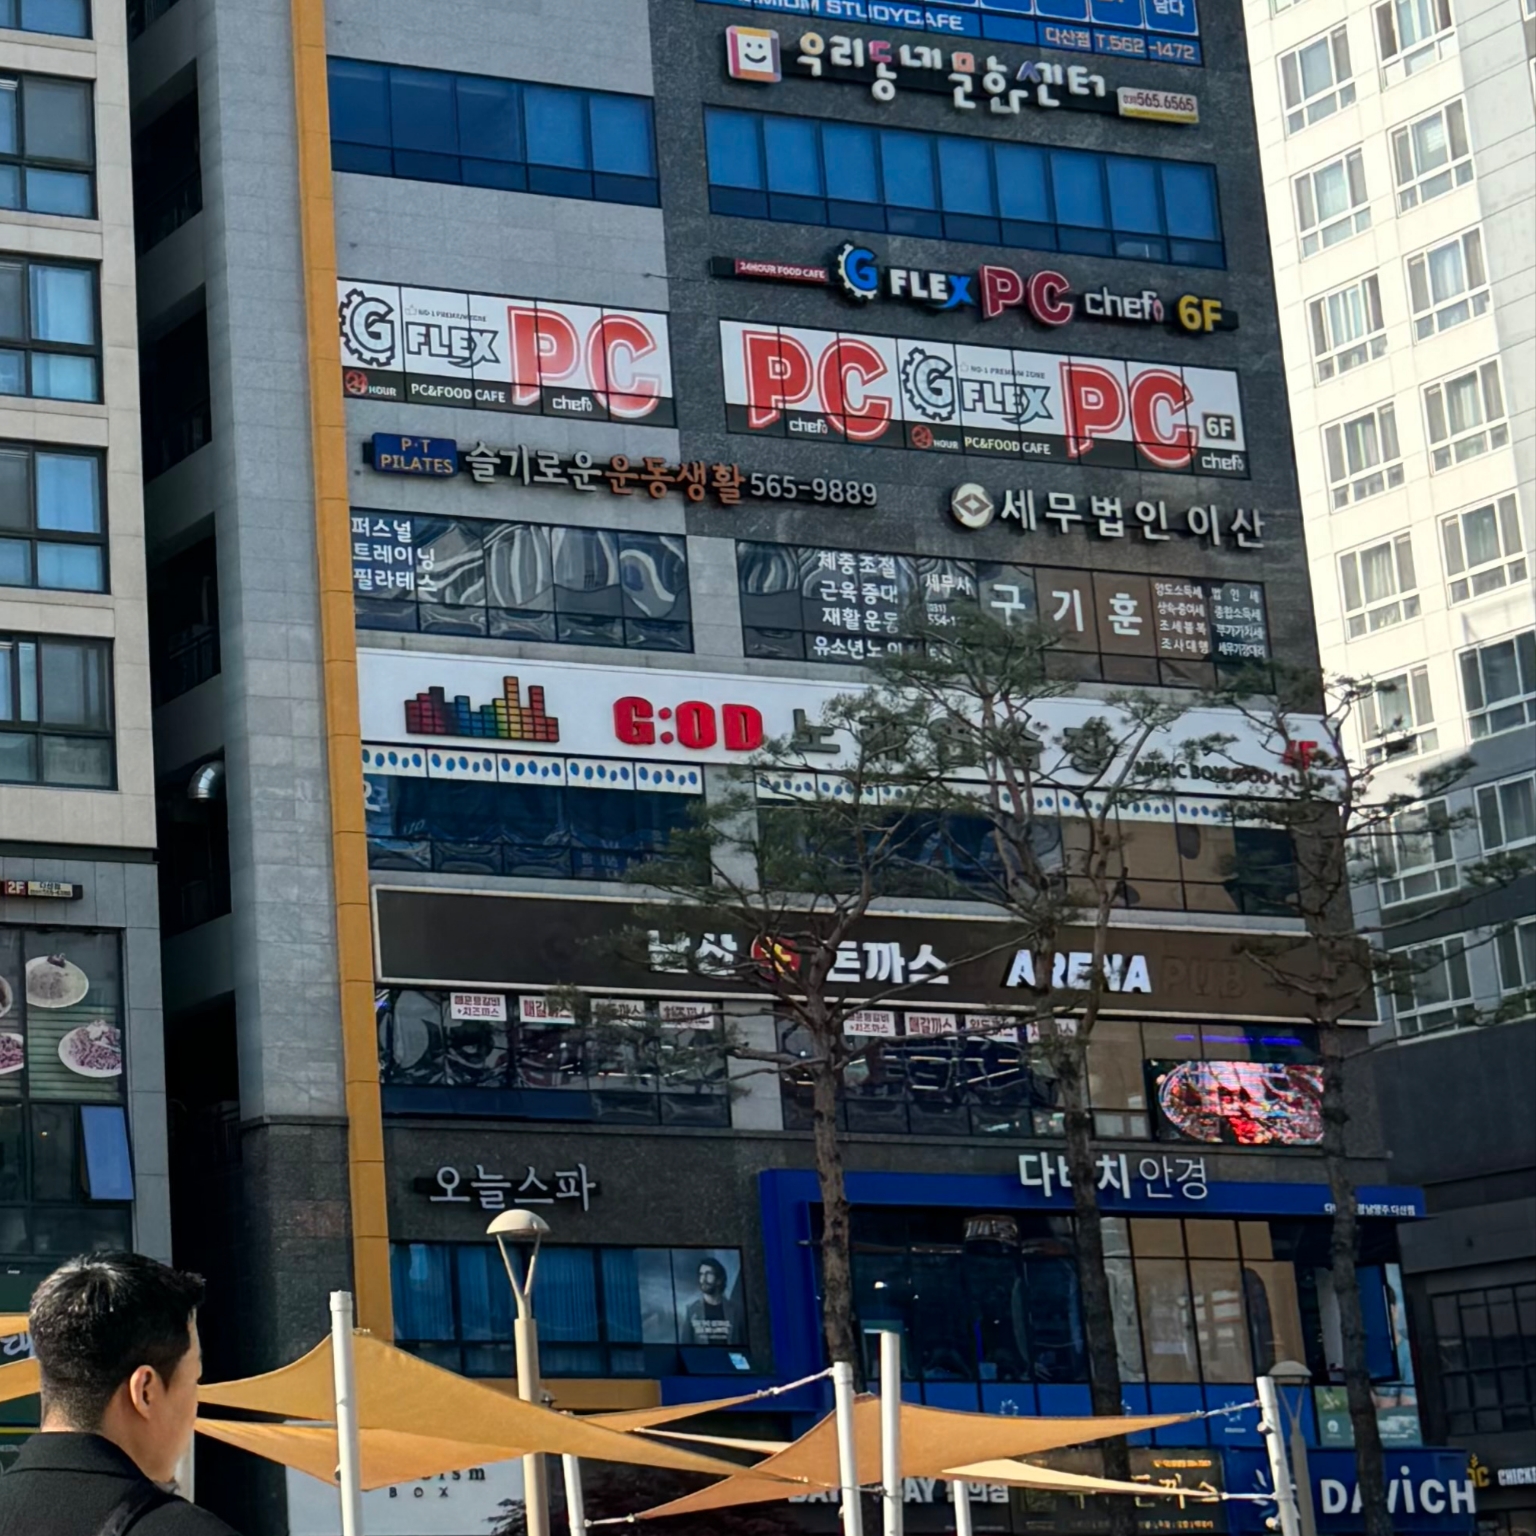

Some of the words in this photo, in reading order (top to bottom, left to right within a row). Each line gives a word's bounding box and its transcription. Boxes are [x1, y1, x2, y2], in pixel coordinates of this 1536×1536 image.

[778, 265, 802, 276] FOOD
[803, 268, 825, 279] CAFE
[889, 268, 977, 310] FLEX
[979, 264, 1074, 325] PC
[1178, 294, 1222, 333] 6F
[404, 321, 501, 369] FLEX
[507, 305, 662, 420] PC
[368, 384, 397, 397] HOUR
[410, 383, 473, 400] PC&FOOD
[474, 389, 506, 403] CAFE
[742, 329, 893, 441] PC
[959, 377, 1055, 425] FLEX
[1059, 361, 1200, 469] PC
[1206, 416, 1233, 440] 6F
[933, 438, 959, 450] HOUR
[964, 436, 1020, 452] PC&FOOD
[1021, 441, 1052, 455] CAFE
[380, 454, 454, 473] PILATES
[750, 473, 877, 507] 565-9889
[350, 516, 412, 543] 퍼스널
[1000, 488, 1171, 542] 세무법인
[1187, 503, 1265, 549] 이산
[352, 543, 436, 572] 트레이닝
[352, 568, 438, 593] 필라테스
[924, 573, 972, 595] 세무사
[7, 881, 25, 895] 2F
[1006, 948, 1153, 994] ARENA
[429, 1163, 596, 1212] 오늘스파
